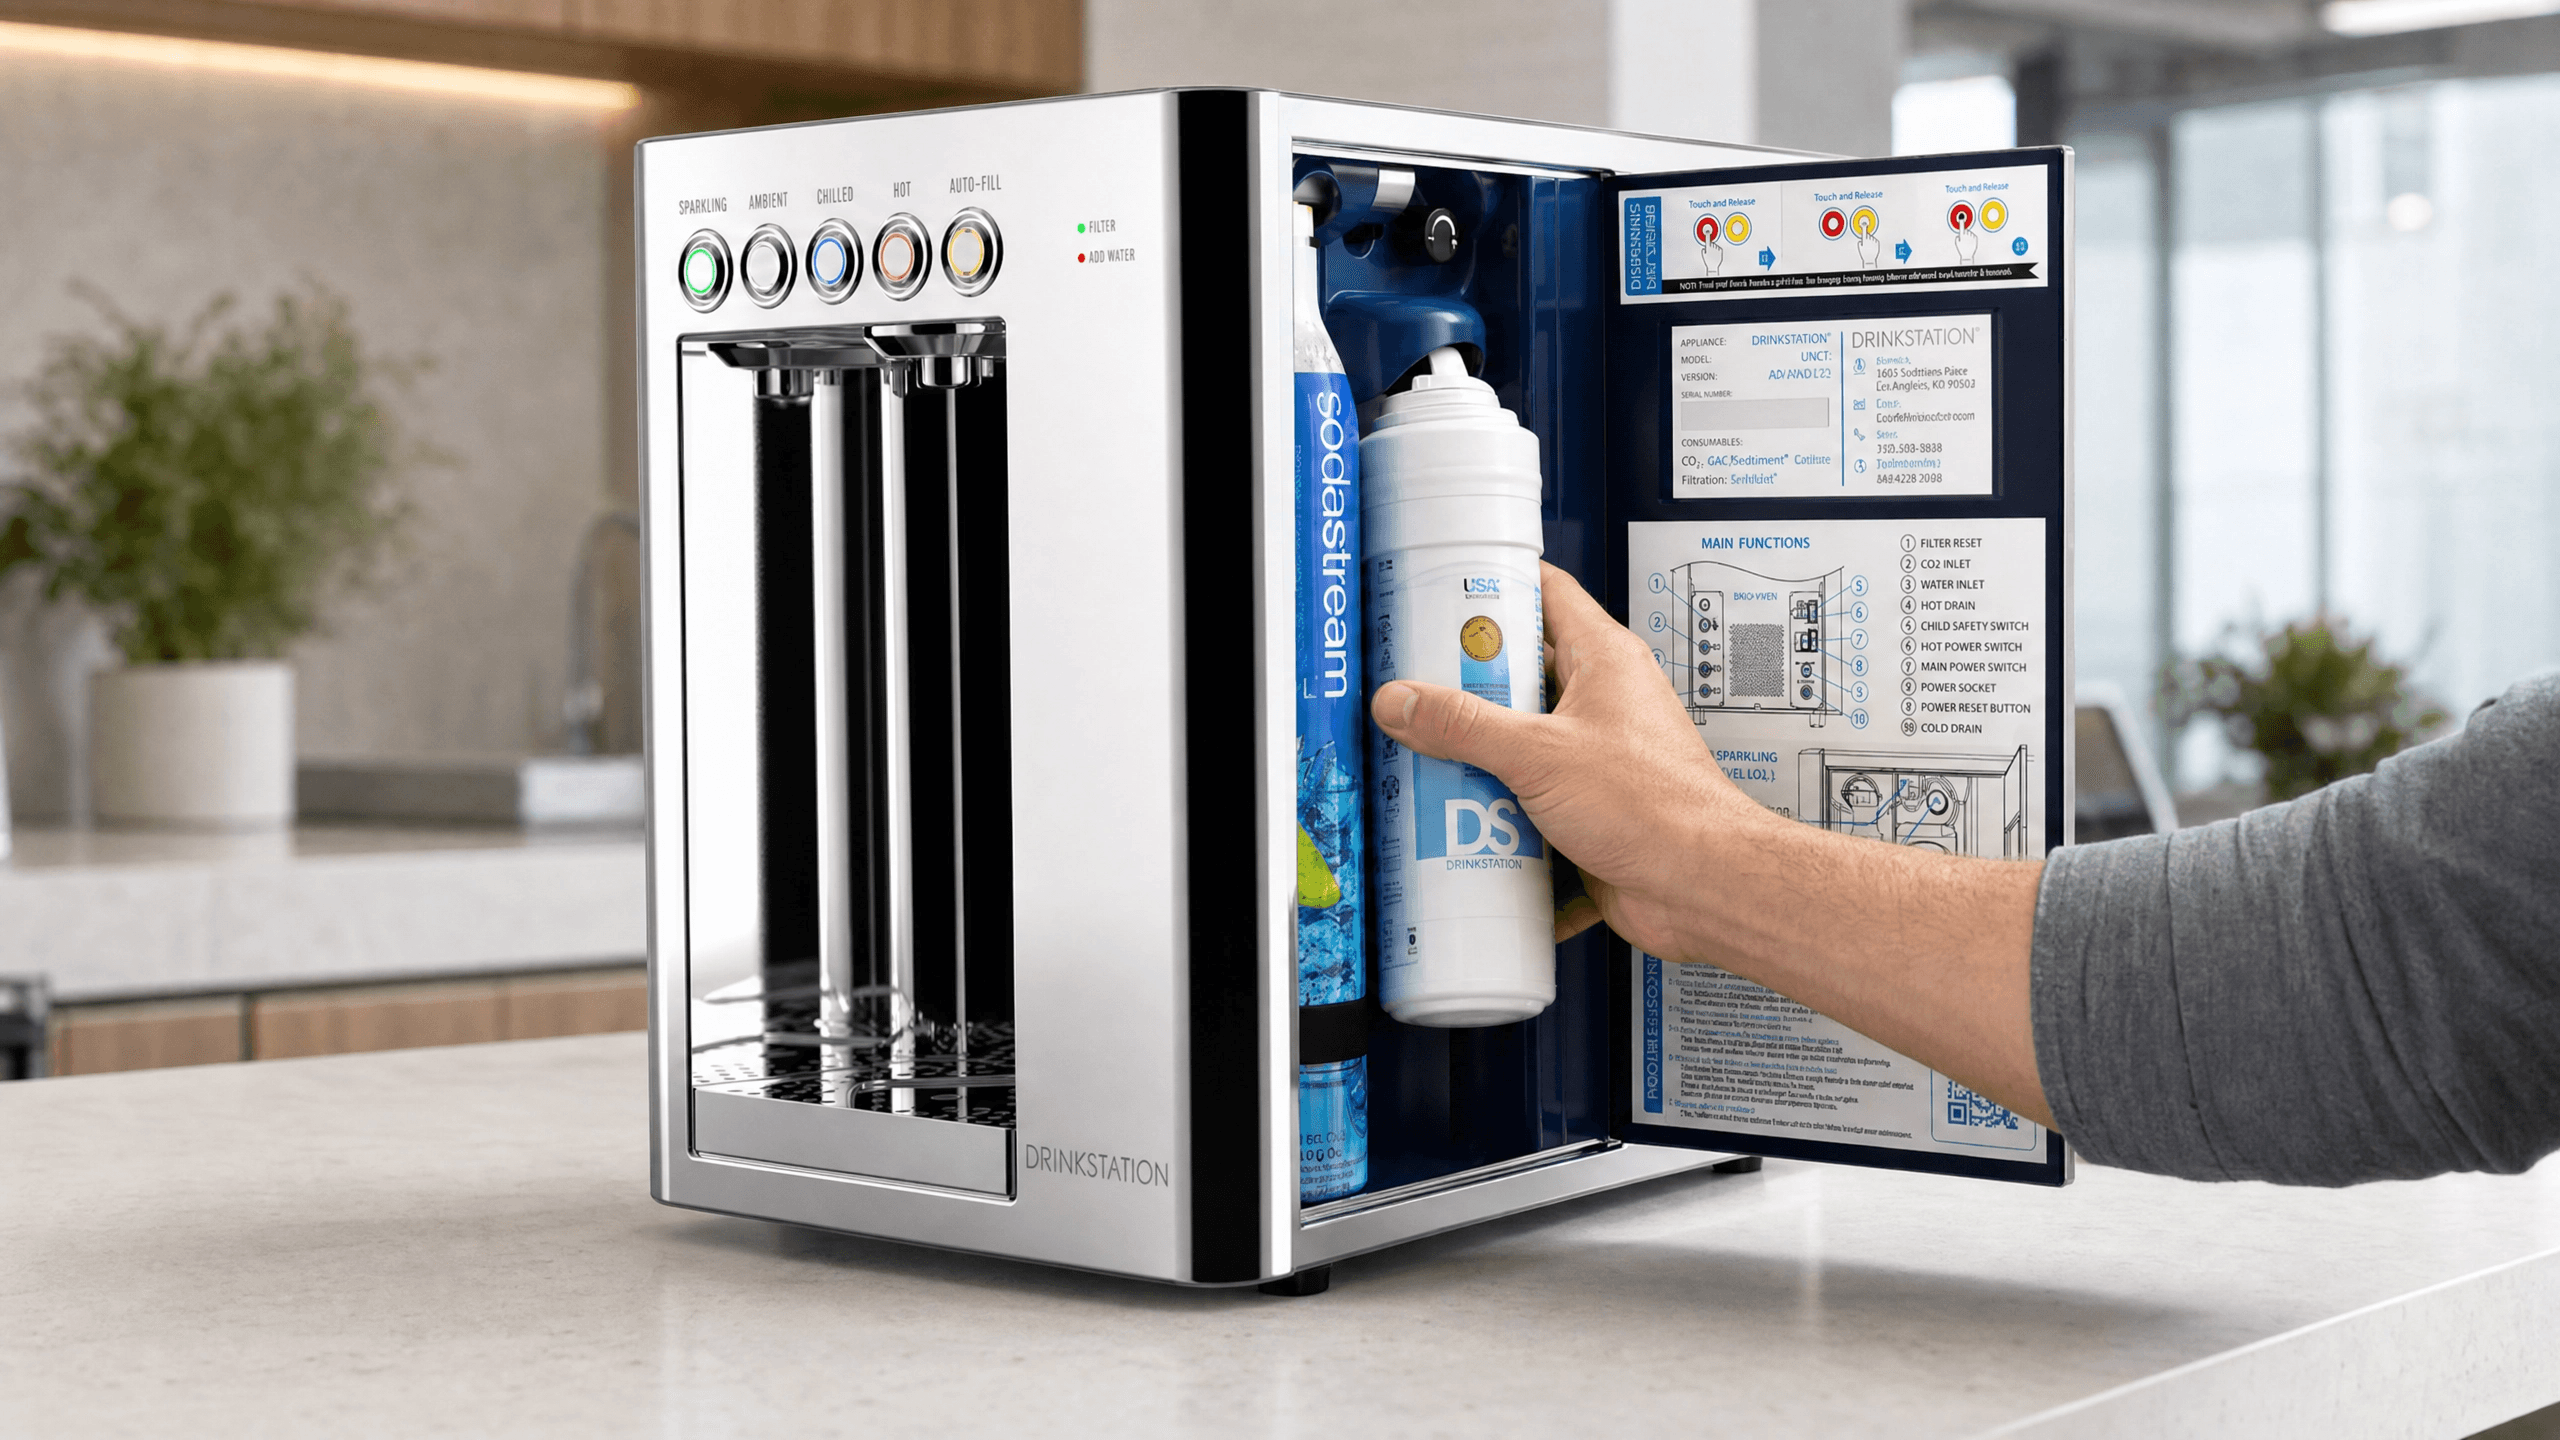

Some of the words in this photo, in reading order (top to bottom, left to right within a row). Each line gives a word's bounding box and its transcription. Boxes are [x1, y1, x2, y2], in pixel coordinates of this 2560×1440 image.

[949, 174, 1002, 194] AUTO-FILL
[1945, 184, 1967, 193] Touch
[1969, 184, 1982, 192] and
[1983, 182, 2009, 191] Release
[893, 181, 911, 198] HOT
[749, 191, 788, 210] AMBIENT
[817, 186, 854, 205] CHILLED
[1814, 193, 1837, 202] Touch
[1839, 192, 1853, 201] and
[1855, 191, 1883, 200] Release
[679, 197, 727, 215] SPARKLING
[1689, 199, 1711, 208] Touch
[1713, 199, 1726, 207] and
[1728, 198, 1756, 206] Release
[1089, 219, 1116, 234] FILTER
[1089, 250, 1105, 264] ADD
[1108, 248, 1135, 263] WATER
[1680, 337, 1727, 347] APPLIANCE:
[1680, 355, 1712, 364] MODEL:
[1681, 372, 1718, 381] VERSION:
[1704, 390, 1732, 398] NUMBER:
[1681, 438, 1743, 447] CONSUMABLES:
[1681, 475, 1728, 485] Filtration:
[1317, 390, 1351, 698] sodastream
[1701, 537, 1733, 549] MAIN
[1739, 537, 1810, 549] FUNCTIONS
[1920, 538, 1951, 548] FILTER
[1953, 538, 1982, 548] RESET
[1920, 559, 1941, 569] CO2
[1943, 559, 1971, 569] INLET
[1920, 580, 1954, 589] WATER
[1956, 580, 1985, 589] INLET
[1921, 601, 1942, 610] HOT
[1944, 601, 1976, 610] DRAIN
[1920, 621, 1951, 631] CHILD
[1953, 621, 1989, 631] SAFETY
[1990, 621, 2029, 631] SWITCH
[1921, 642, 1942, 652] HOT
[1944, 642, 1982, 652] POWER
[1984, 642, 2023, 652] SWITCH
[1921, 662, 1947, 672] MAIN
[1949, 662, 1985, 672] POWER
[1988, 662, 2027, 672] SWITCH
[1921, 683, 1957, 692] POWER
[1958, 683, 1997, 693] SOCKET
[1921, 702, 1957, 712] POWER
[1959, 703, 1988, 713] RESET
[1990, 703, 2031, 713] BUTTON
[1920, 723, 1949, 733] COLD
[1951, 723, 1982, 733] DRAIN
[1716, 750, 1778, 763] SPARKLING
[1445, 798, 1520, 856] DS
[1446, 858, 1522, 870] DRINKSTATION
[1025, 1143, 1169, 1188] DRINKSTATION
